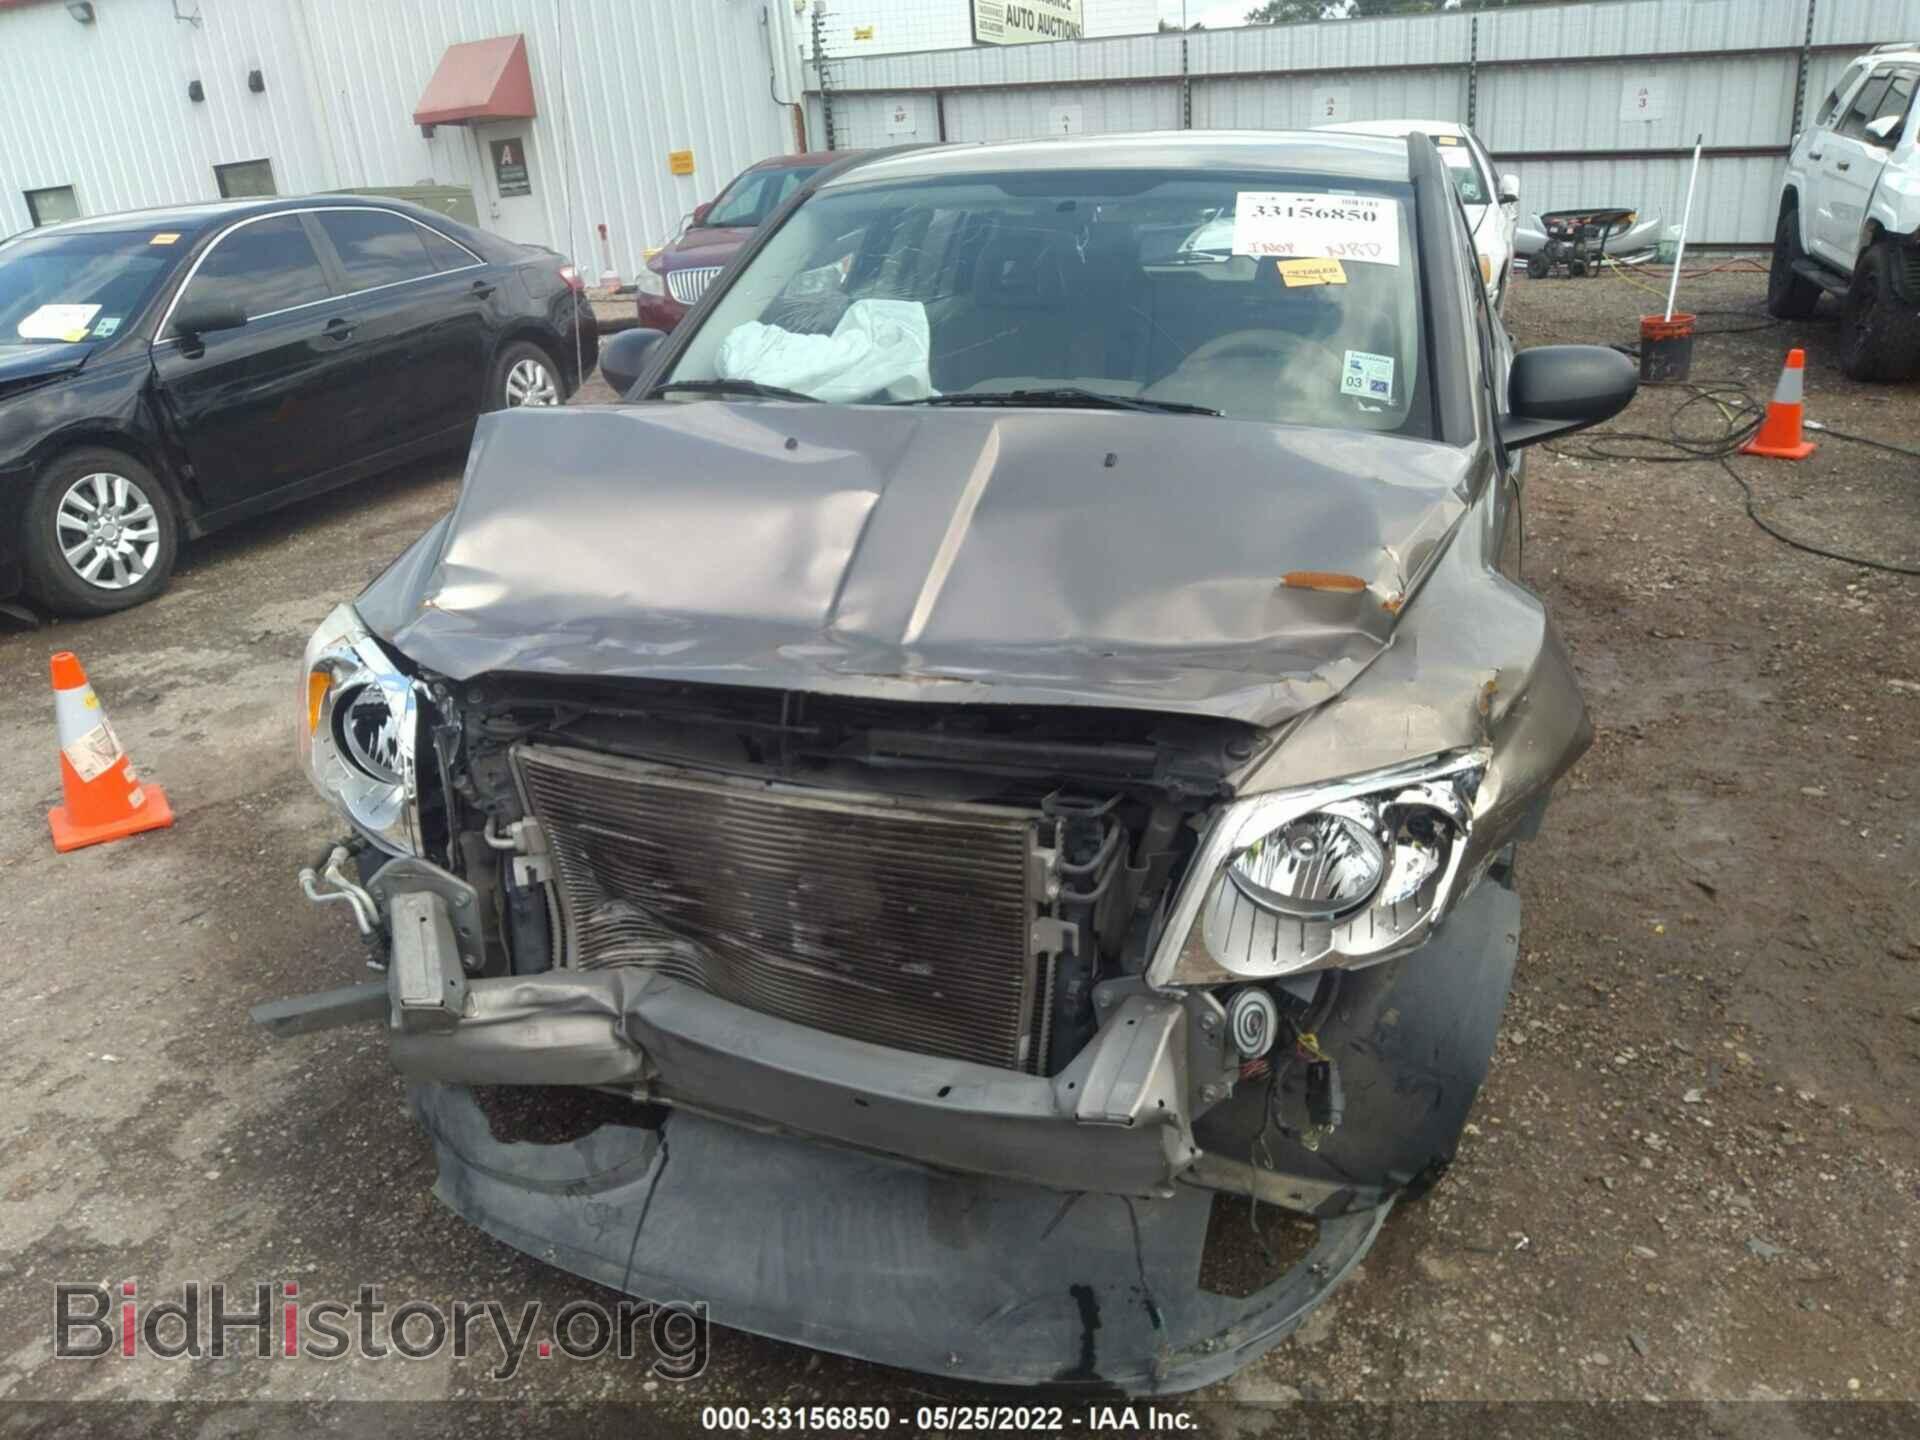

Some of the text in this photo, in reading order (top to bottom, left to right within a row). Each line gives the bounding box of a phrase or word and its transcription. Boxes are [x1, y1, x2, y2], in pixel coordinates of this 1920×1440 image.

[1006, 4, 1034, 31] AUTO
[1037, 12, 1081, 39] AUCTIONS
[1639, 98, 1647, 108] 3
[1327, 106, 1335, 116] 2
[1251, 205, 1377, 222] 33156850
[1346, 376, 1362, 388] 03
